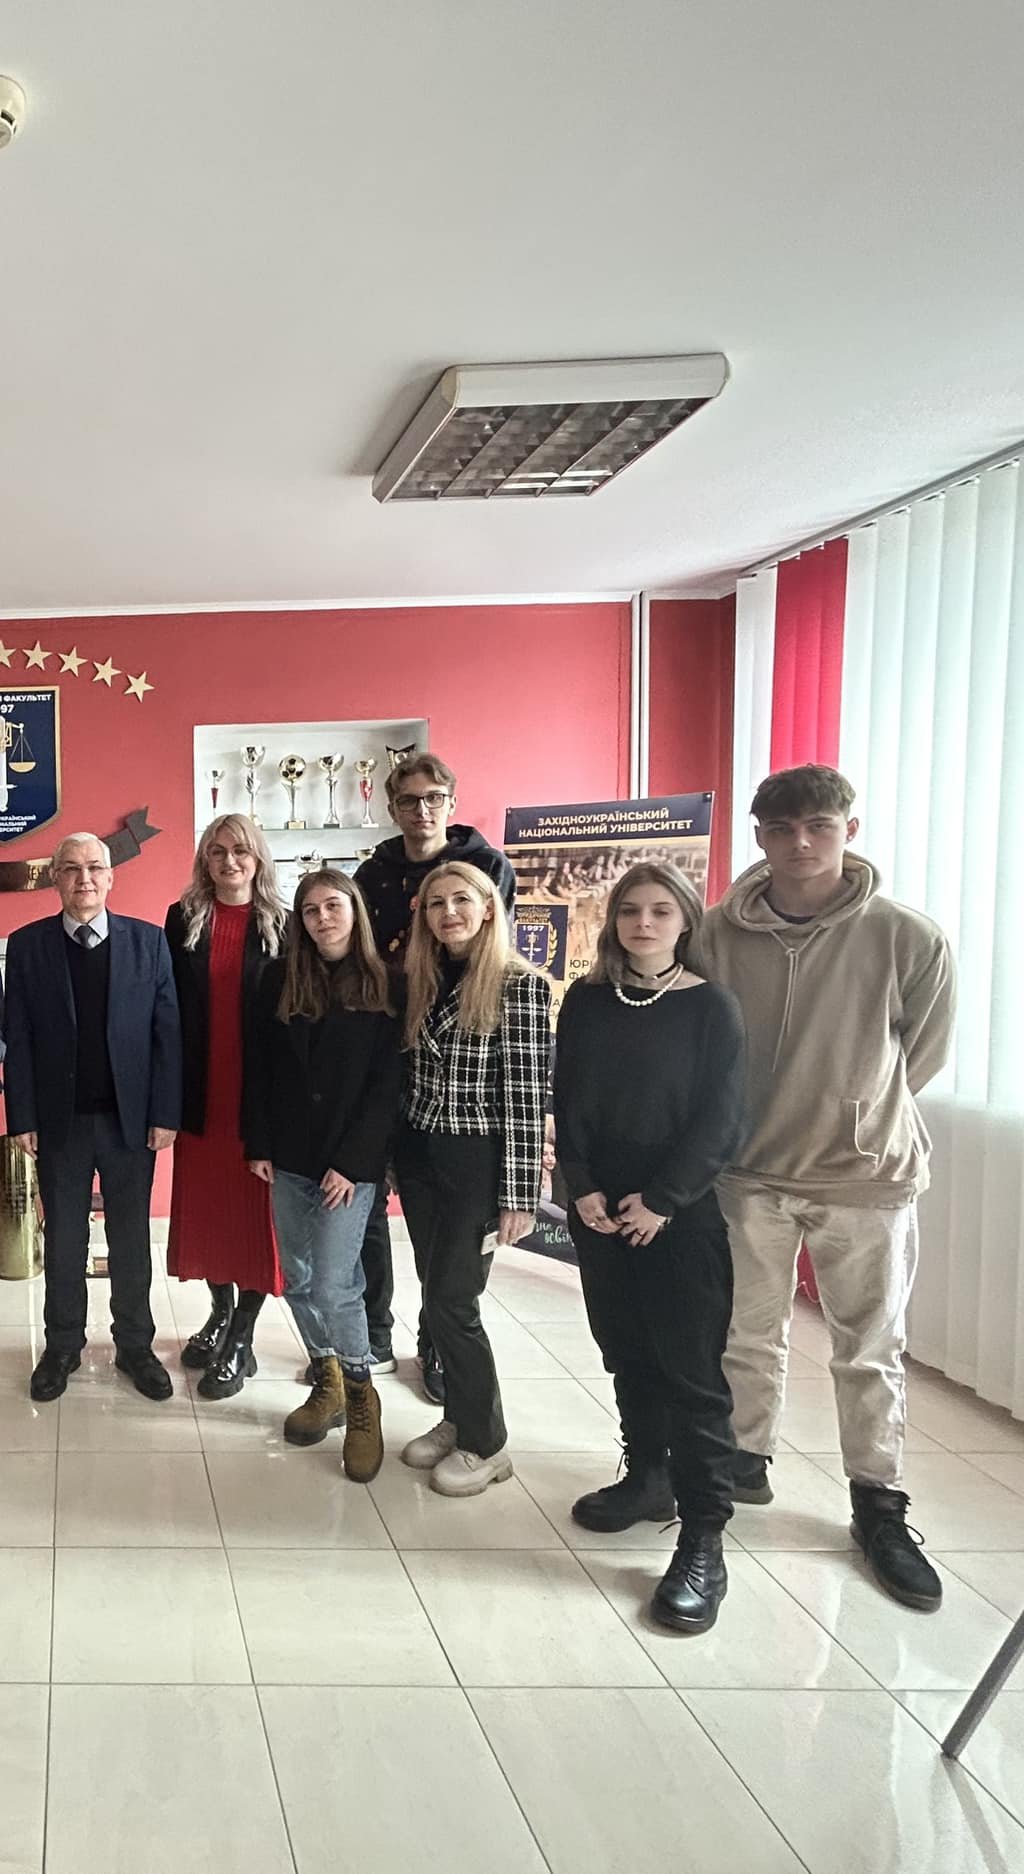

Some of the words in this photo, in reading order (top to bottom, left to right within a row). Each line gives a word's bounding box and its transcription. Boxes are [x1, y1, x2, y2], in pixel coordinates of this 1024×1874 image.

[3, 694, 52, 702] ФАКУЛЬТЕТ
[538, 808, 669, 826] ЗАХІДНОУКРАЇНСЬКИЙ
[519, 822, 607, 838] НАЦІОНАЛЬНИЙ
[610, 820, 693, 833] УНІВЕРСИТЕТ
